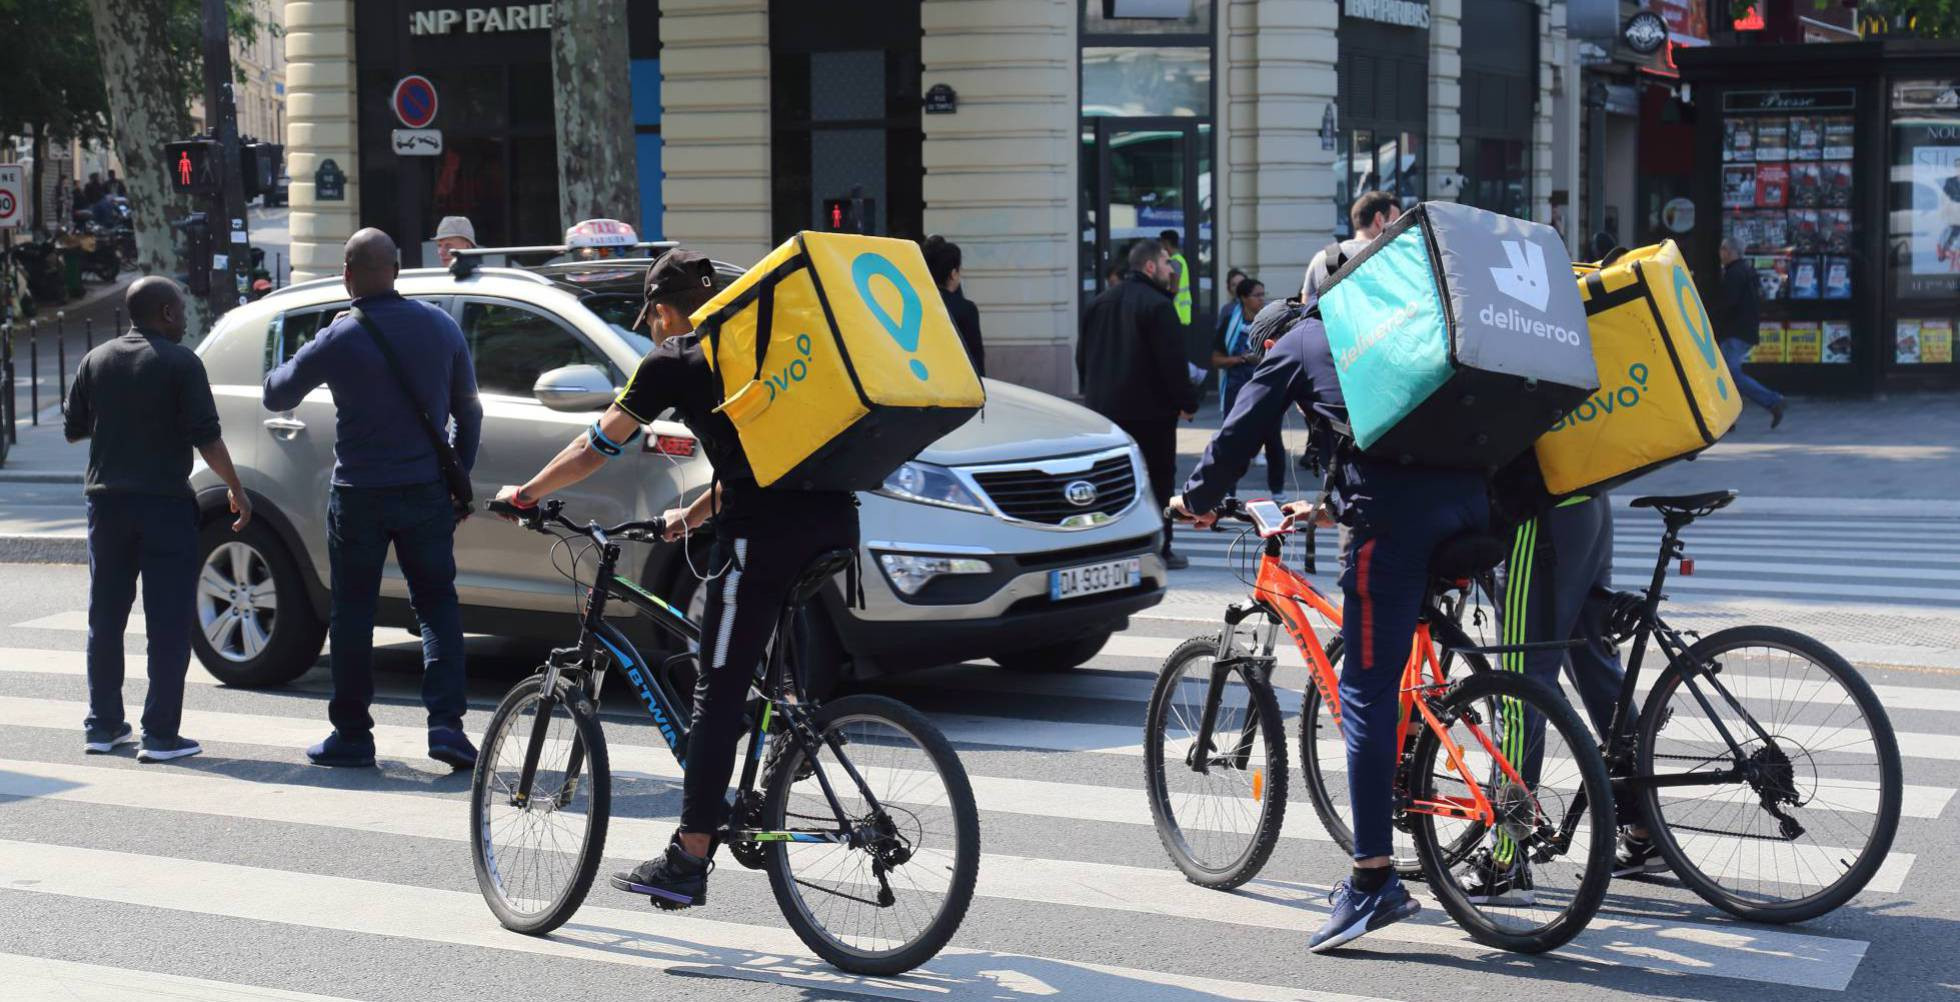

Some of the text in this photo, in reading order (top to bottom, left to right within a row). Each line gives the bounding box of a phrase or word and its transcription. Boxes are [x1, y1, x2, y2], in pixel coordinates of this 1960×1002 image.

[0, 197, 11, 211] 0
[591, 223, 618, 234] TAXI
[1338, 301, 1419, 374] deliveroo
[1480, 304, 1580, 346] deliveroo
